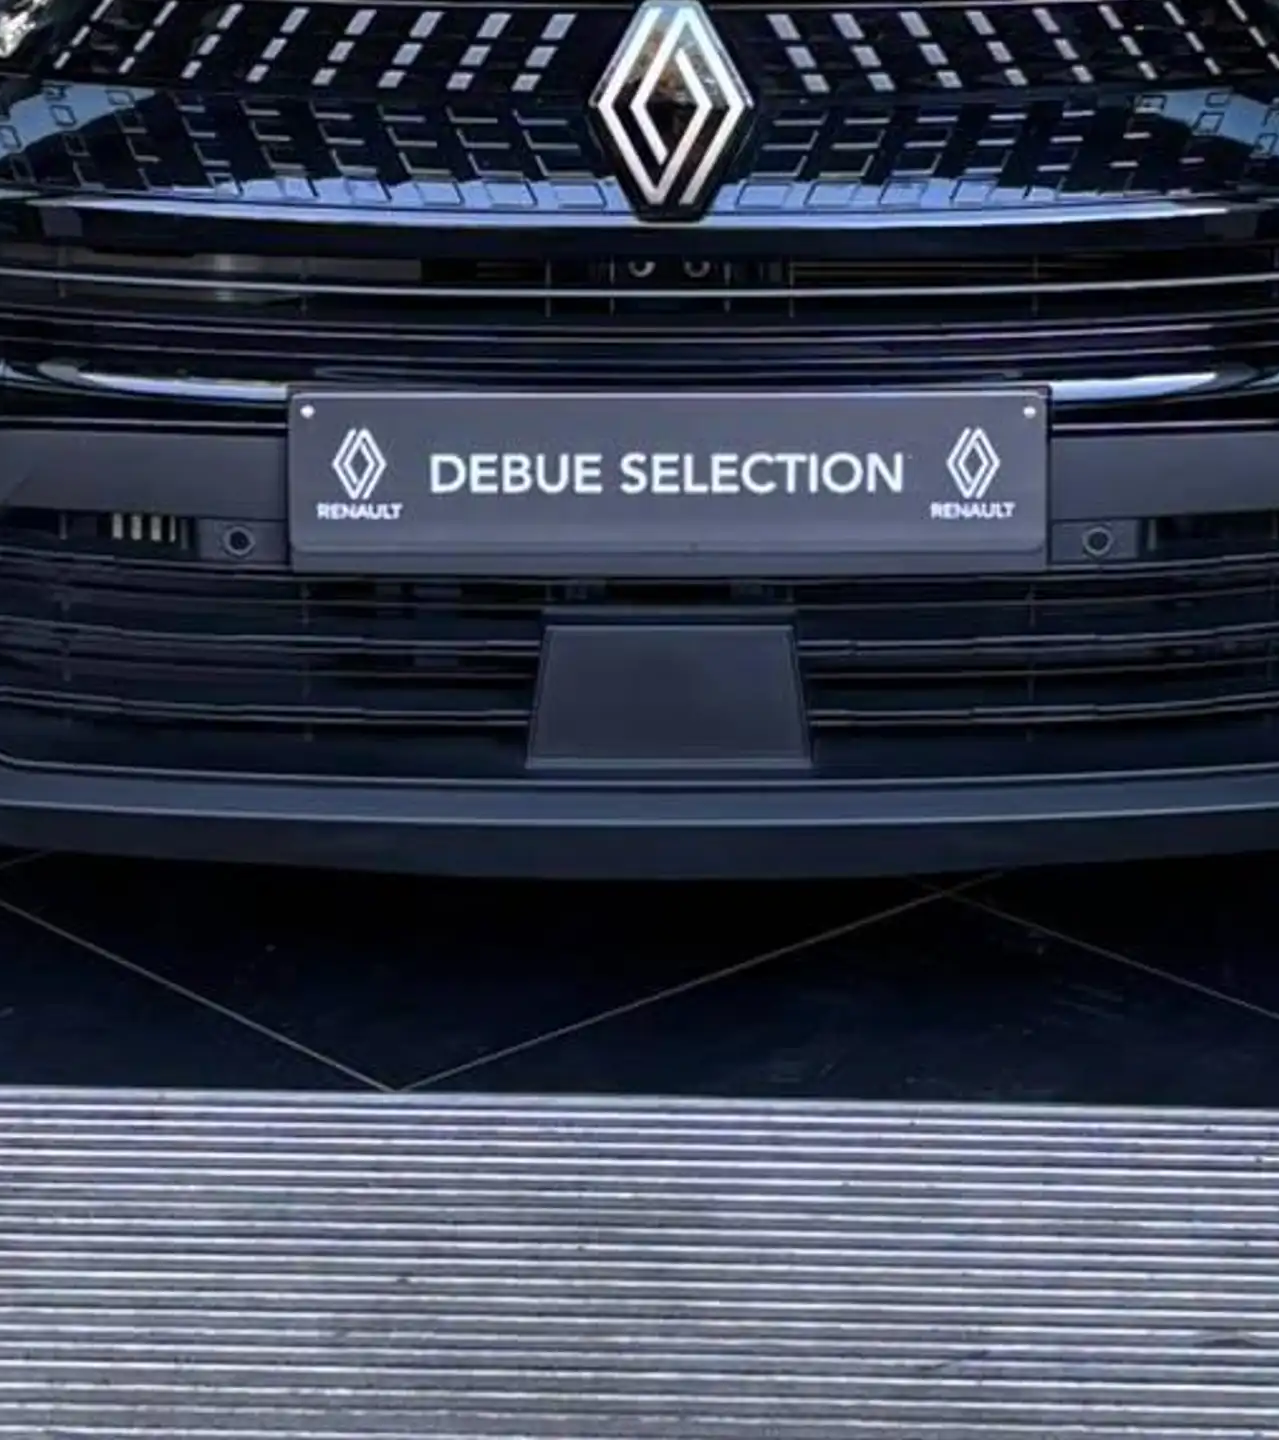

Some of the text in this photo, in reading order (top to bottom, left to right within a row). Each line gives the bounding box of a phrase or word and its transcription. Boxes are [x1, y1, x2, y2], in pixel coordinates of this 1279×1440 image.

[429, 452, 904, 495] DEBUE SELECTION
[316, 502, 402, 521] RENAULT
[929, 501, 1016, 520] RENAULT
